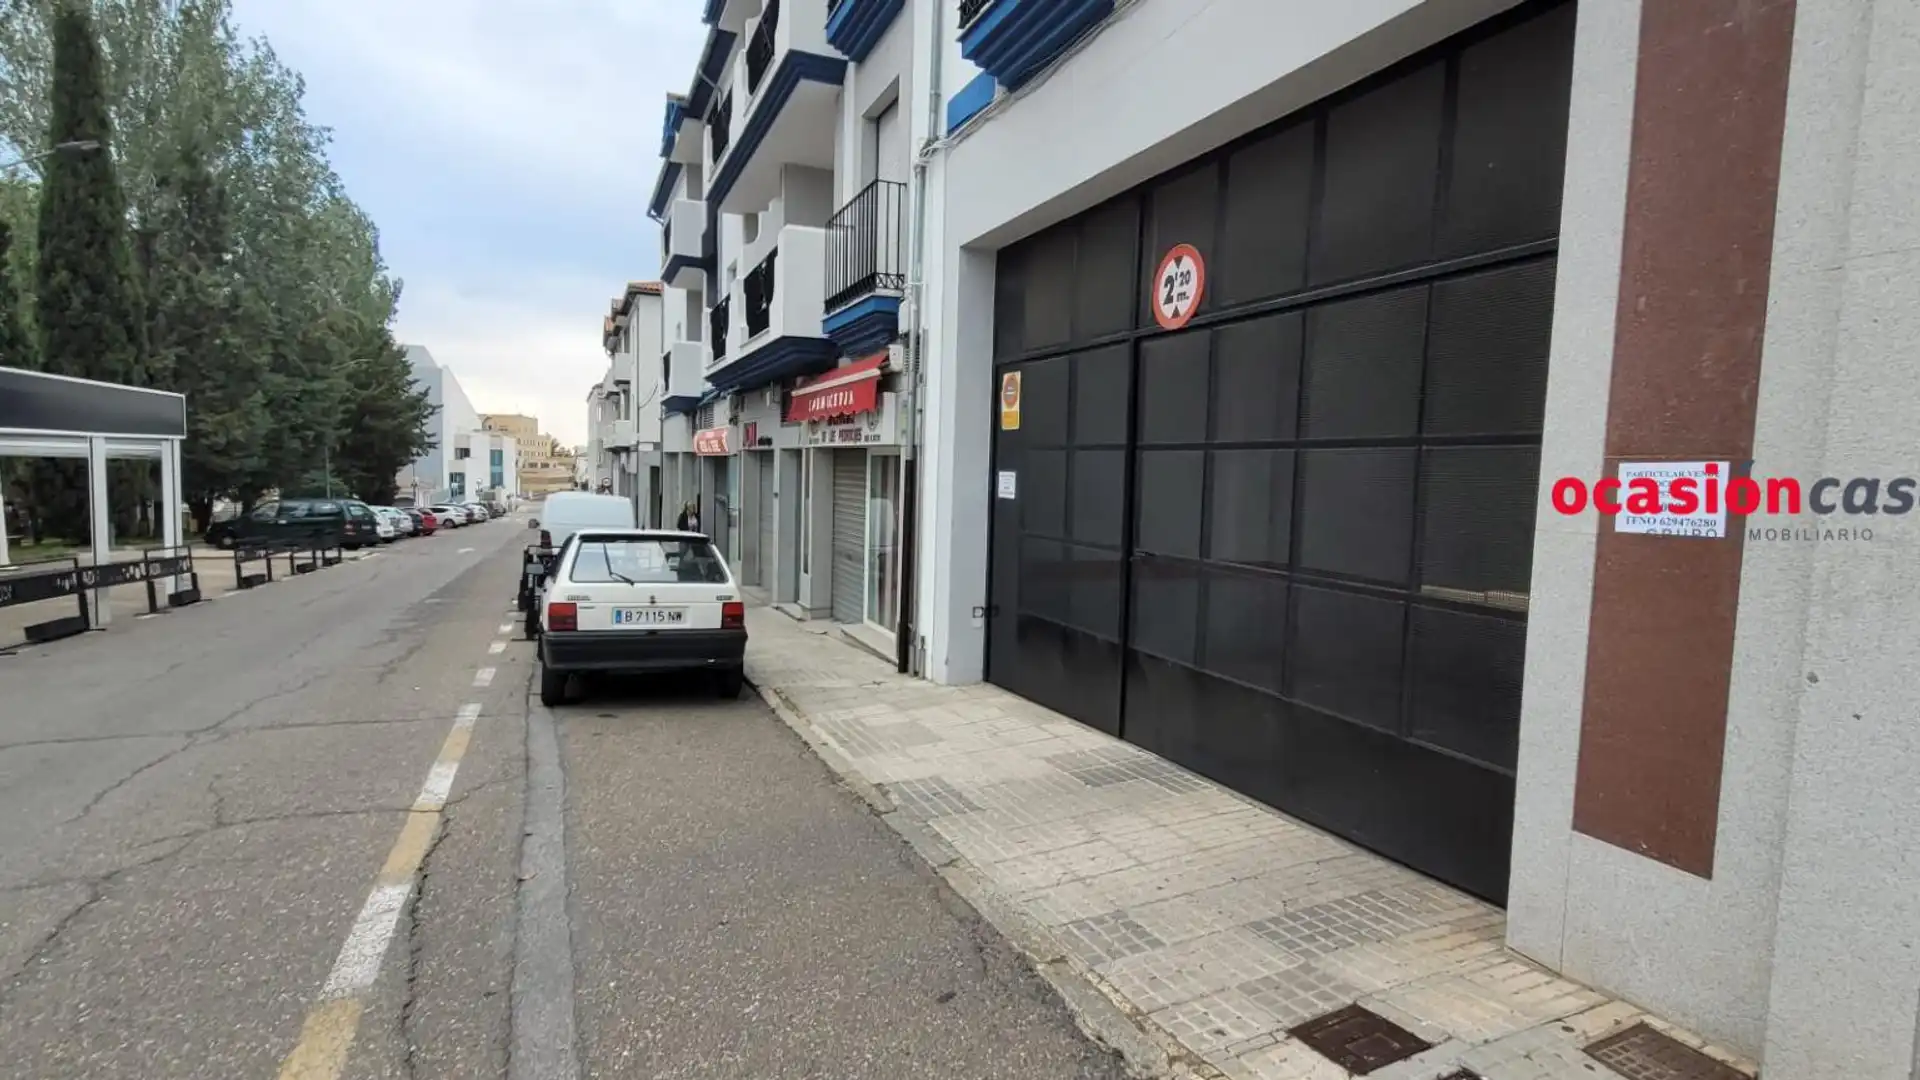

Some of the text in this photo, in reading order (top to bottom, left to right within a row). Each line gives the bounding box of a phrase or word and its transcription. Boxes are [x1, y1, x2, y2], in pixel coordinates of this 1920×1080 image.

[1659, 517, 1717, 527] 629476280
[625, 611, 632, 622] B
[636, 611, 665, 622] 7115
